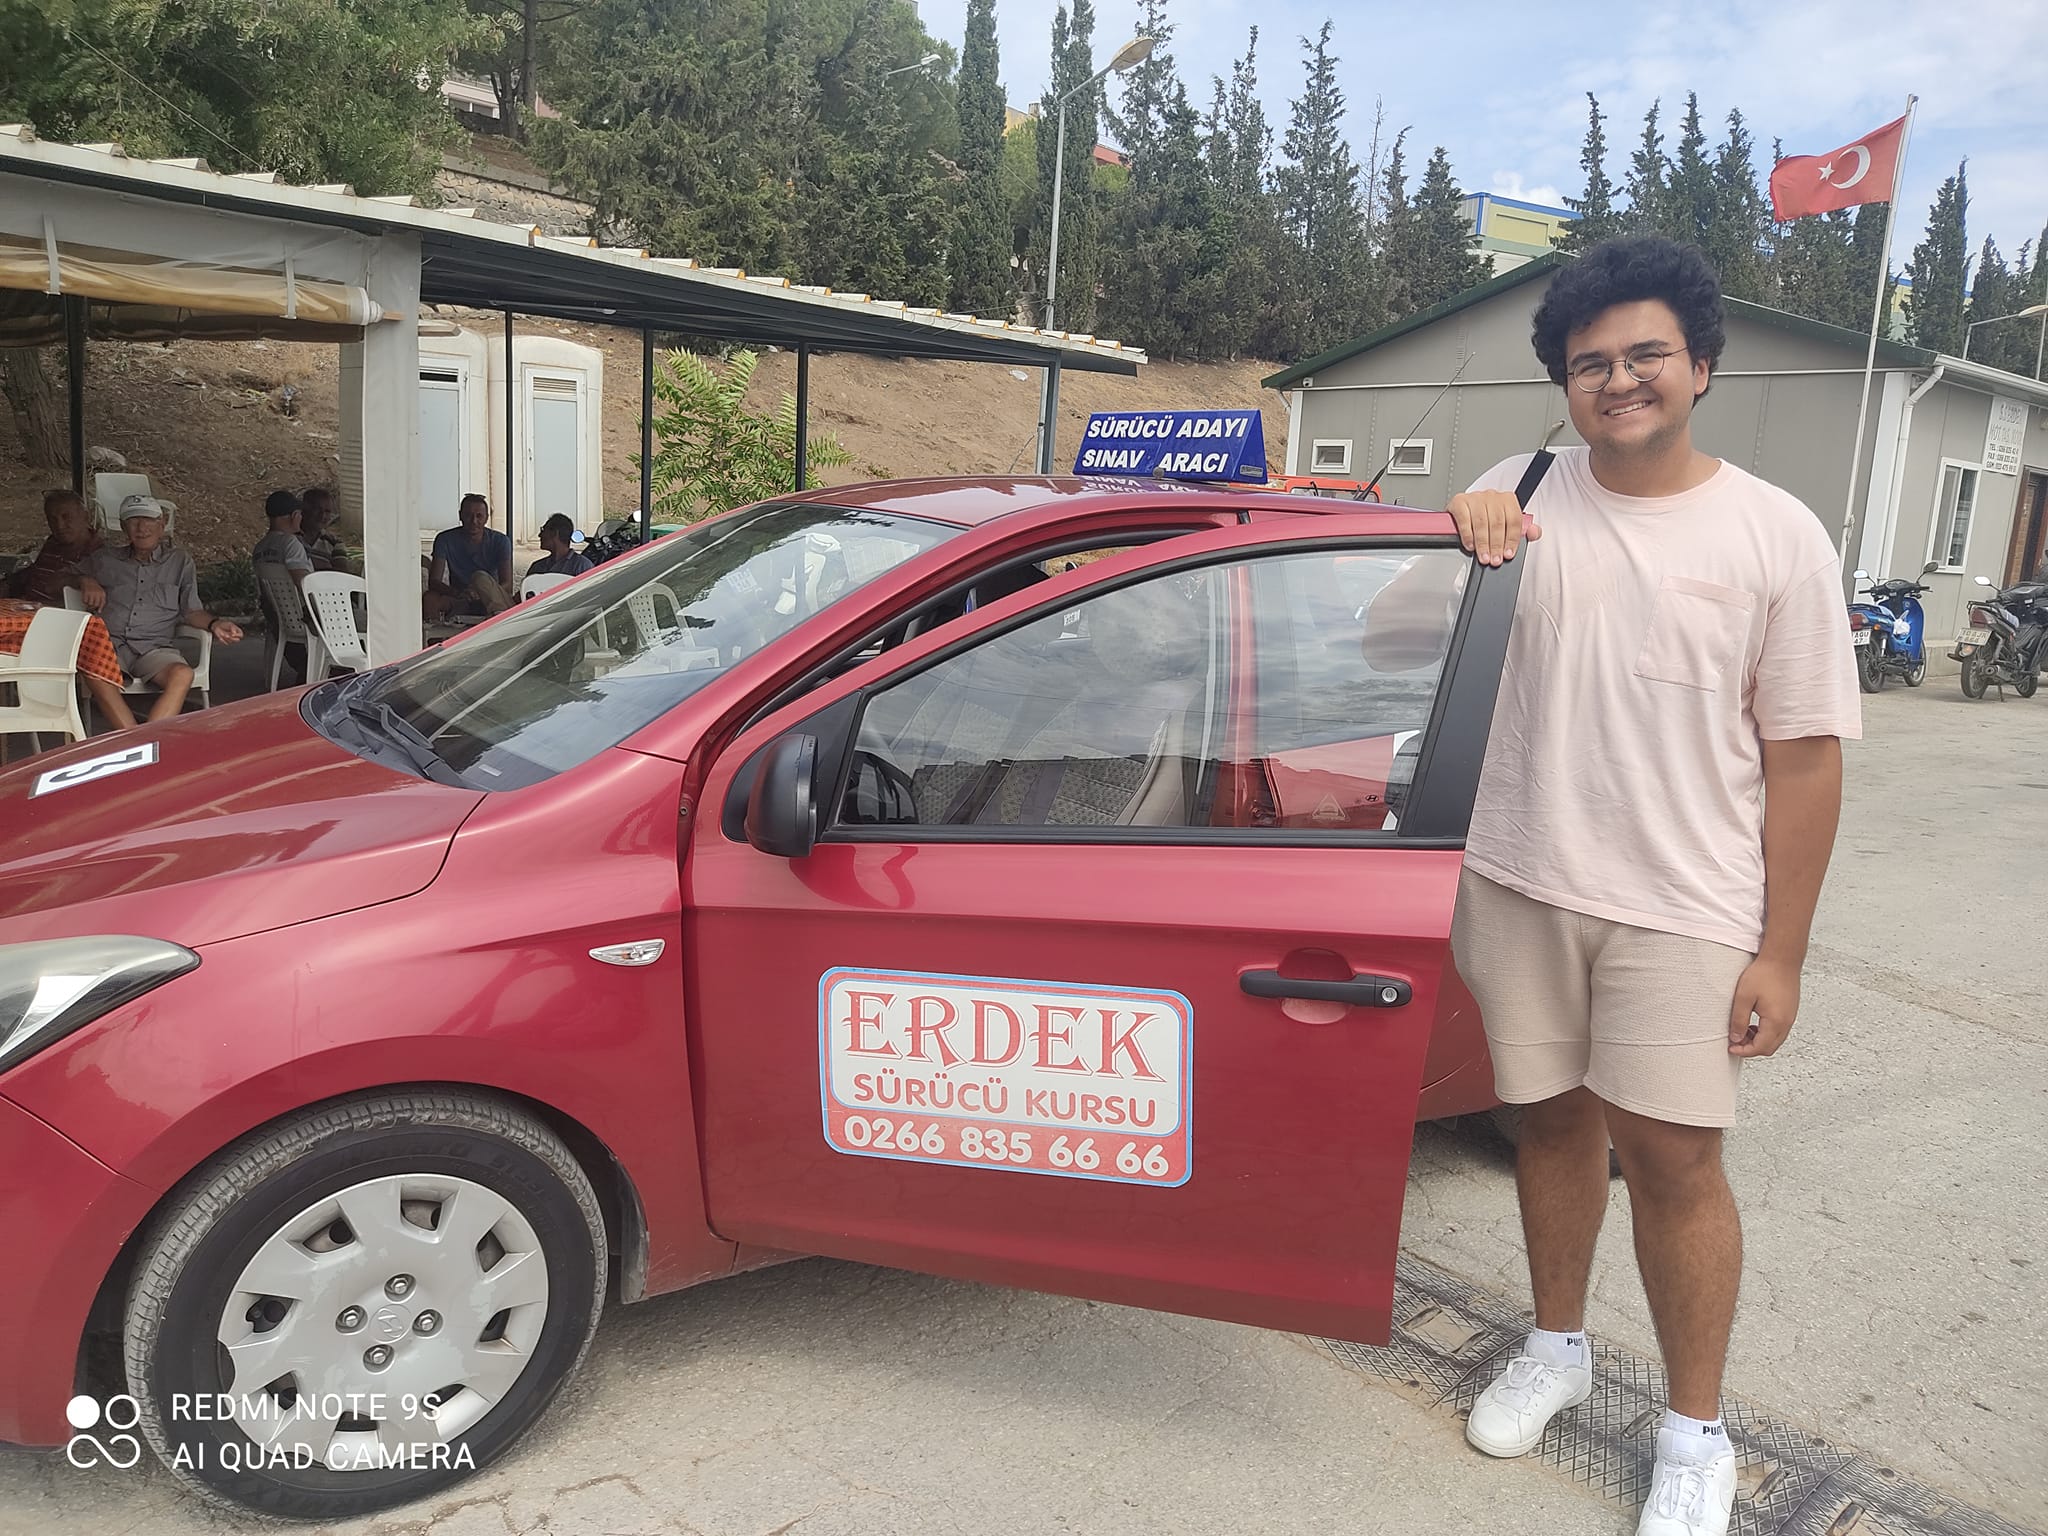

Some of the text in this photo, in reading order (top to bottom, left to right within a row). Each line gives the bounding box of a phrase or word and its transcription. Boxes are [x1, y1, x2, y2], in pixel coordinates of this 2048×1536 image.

[1087, 415, 1248, 438] SÜRÜCÜ ADAYI
[1158, 452, 1229, 473] ARACI
[842, 990, 1167, 1083] ERDEK
[854, 1068, 1156, 1128] SÜRÜCÜ KURSU
[844, 1116, 1169, 1176] 0266 835 66 66
